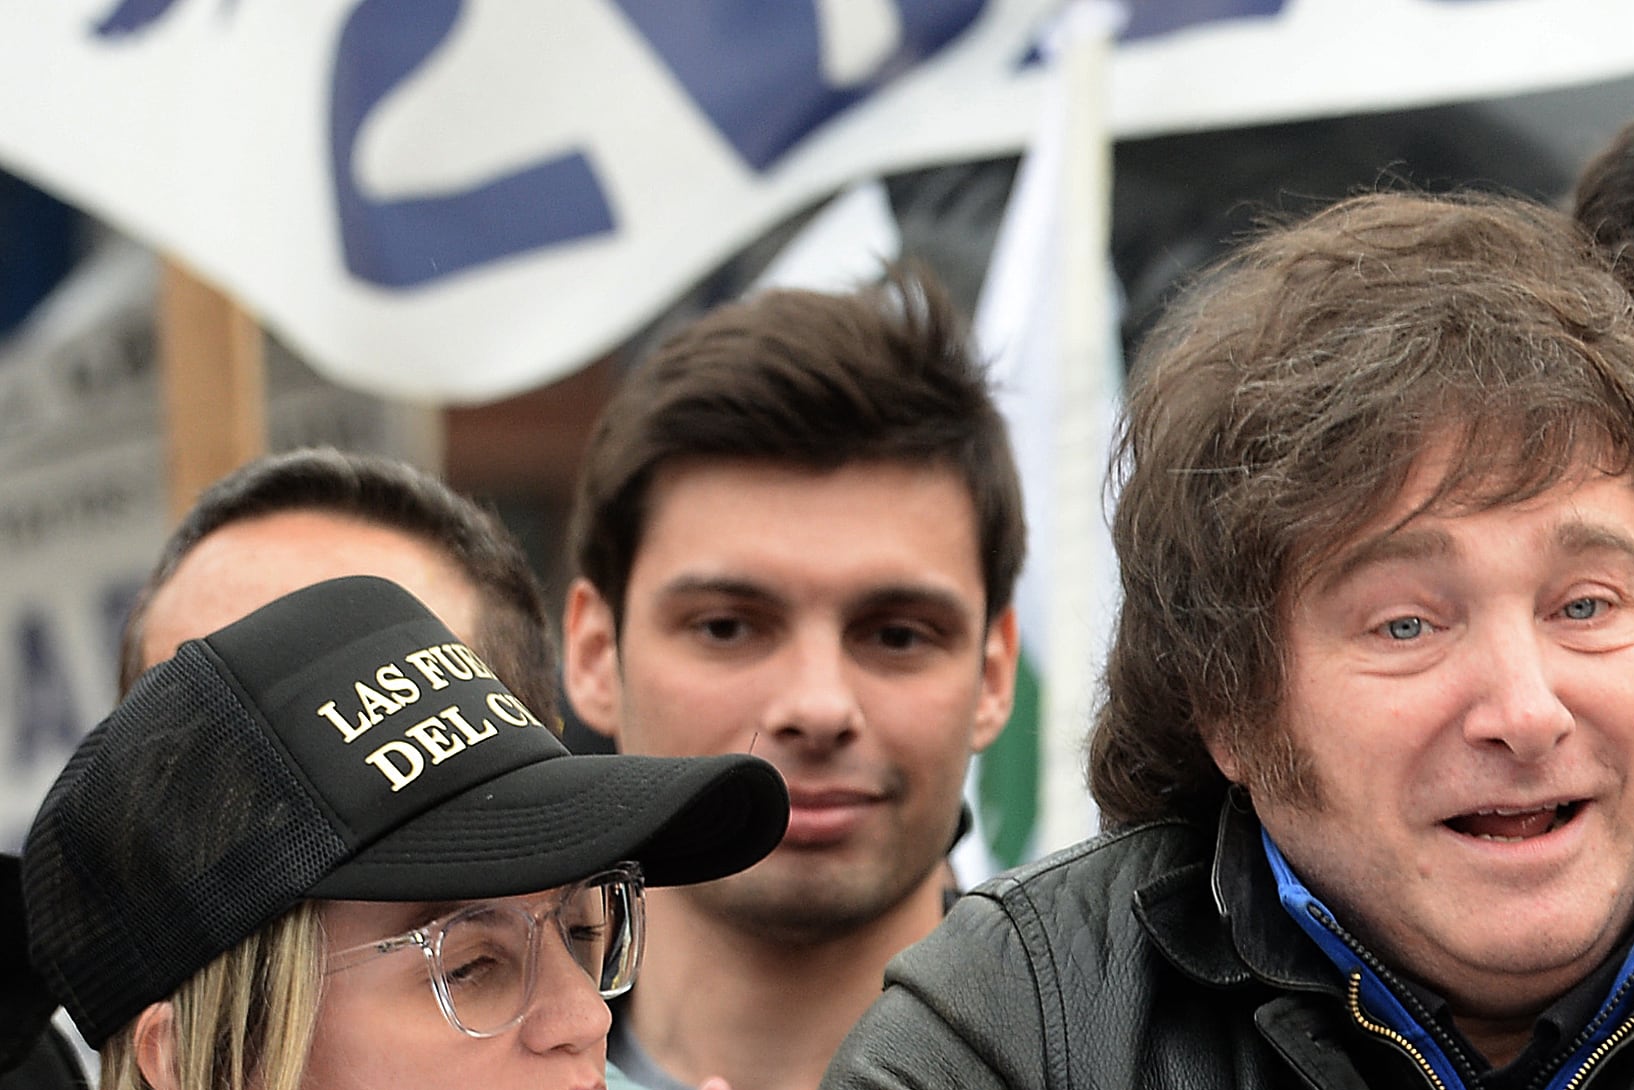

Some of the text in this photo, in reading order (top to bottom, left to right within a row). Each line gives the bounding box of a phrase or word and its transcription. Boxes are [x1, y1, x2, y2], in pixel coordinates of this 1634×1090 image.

[317, 643, 498, 744] LAS FUE
[365, 705, 498, 792] DEL
